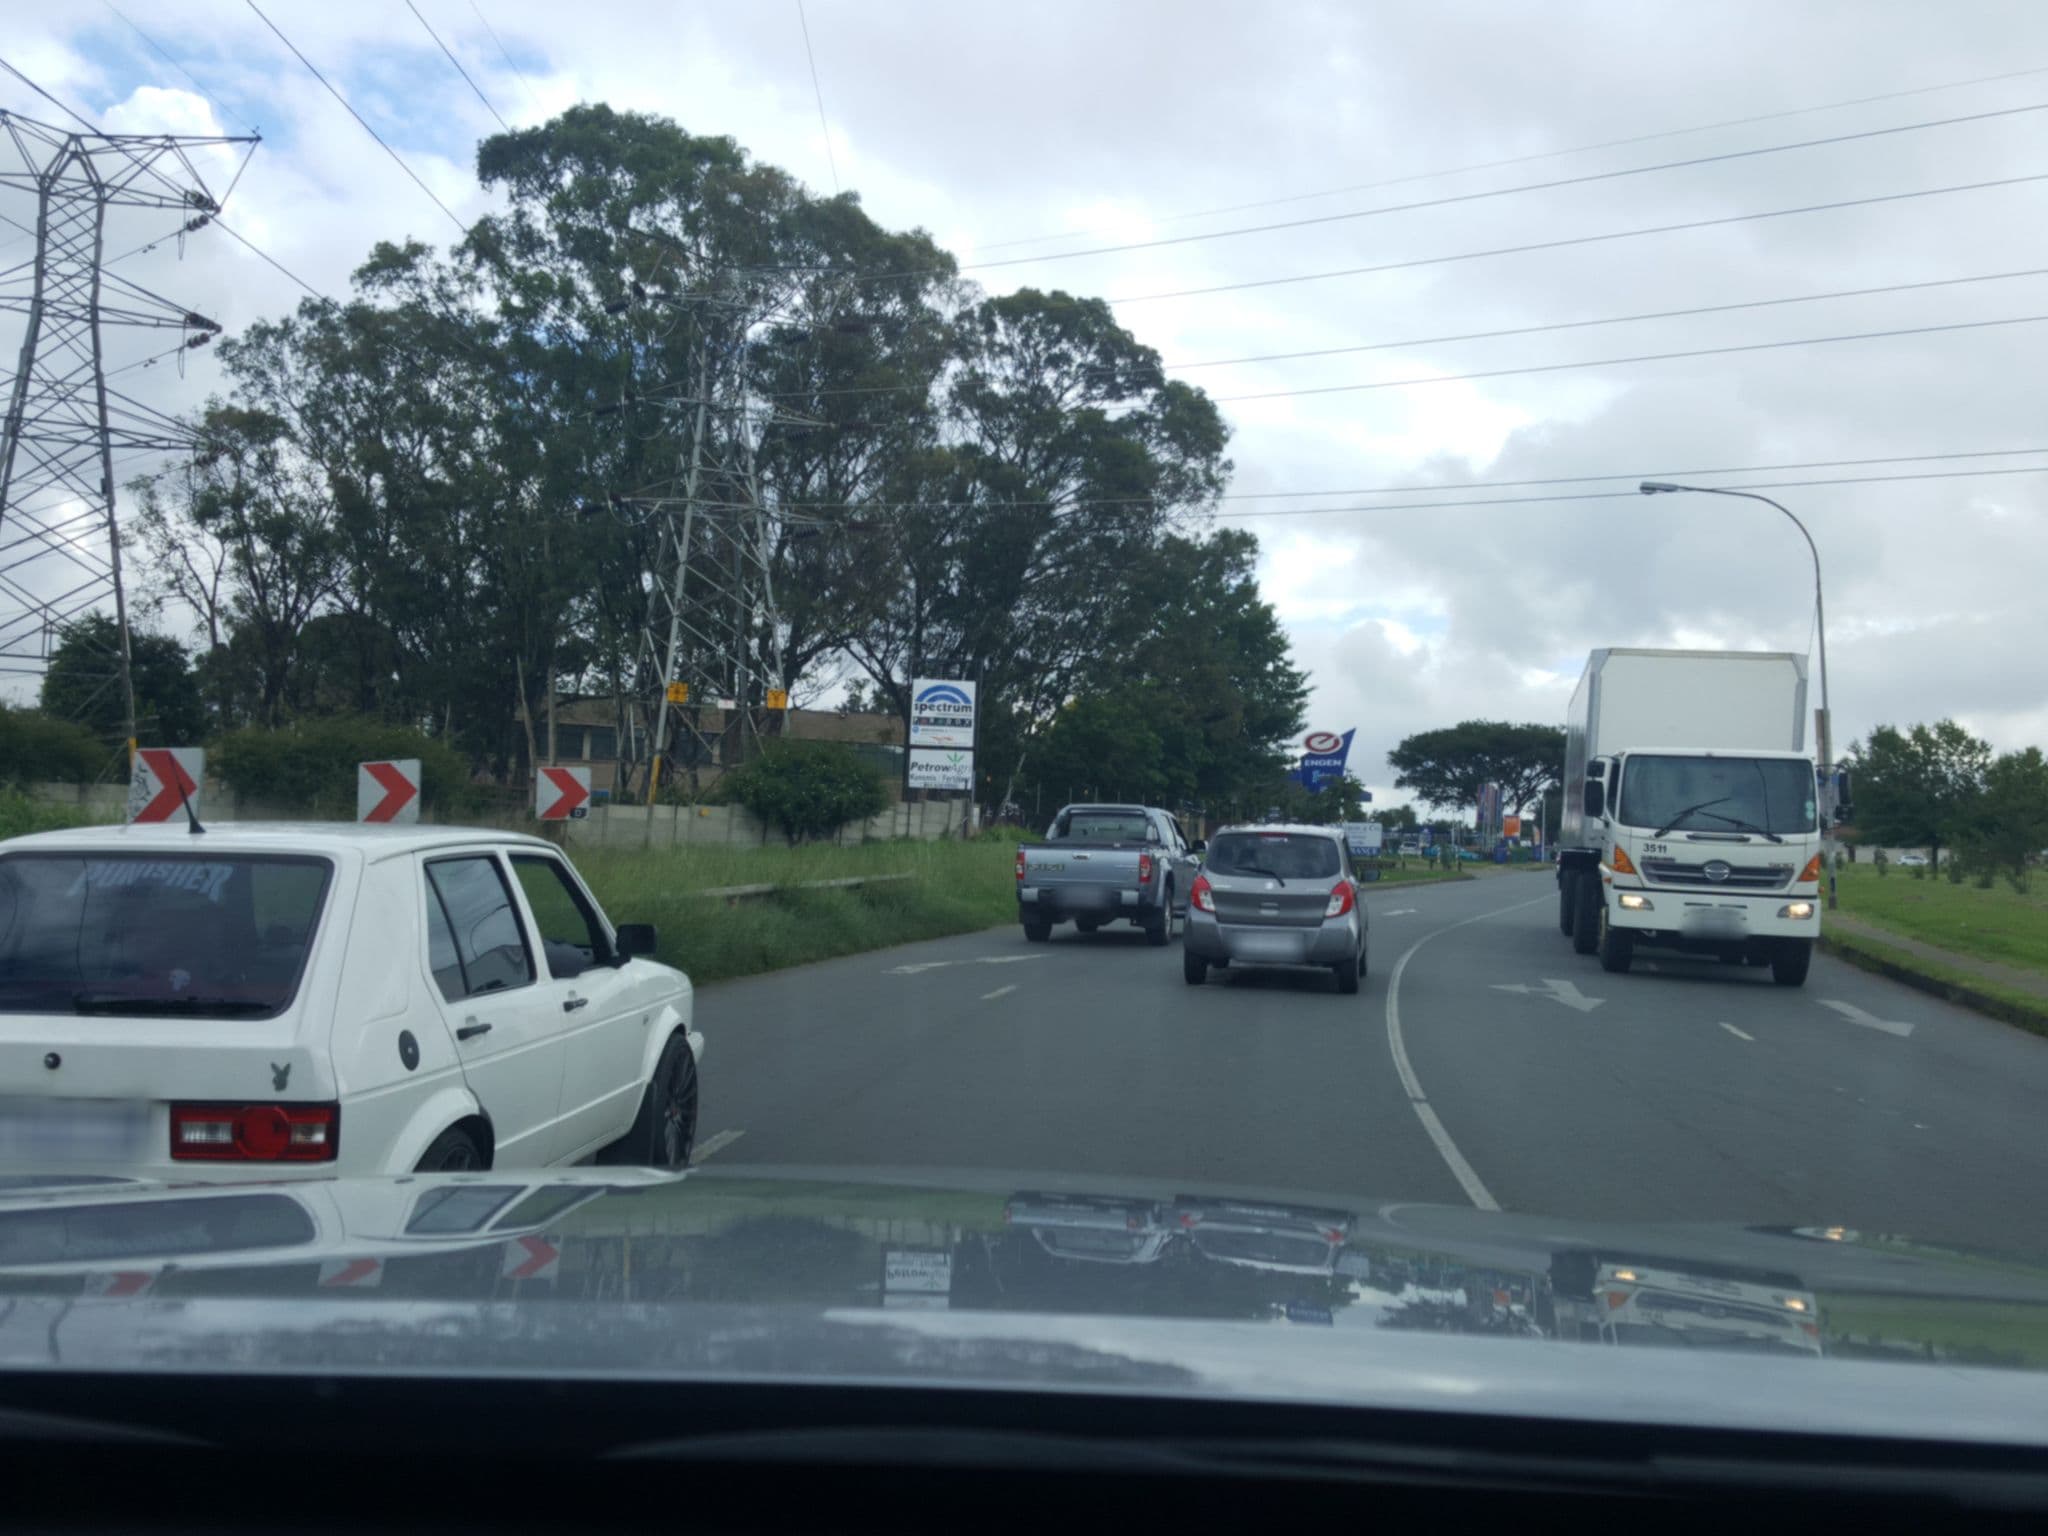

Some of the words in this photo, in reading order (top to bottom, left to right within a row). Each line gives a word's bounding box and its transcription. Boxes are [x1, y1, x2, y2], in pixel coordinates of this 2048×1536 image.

[1304, 759, 1342, 767] ENGEN
[1643, 843, 1667, 853] 3511
[1026, 863, 1065, 872] ISUZU
[66, 863, 235, 902] PUNISHER
